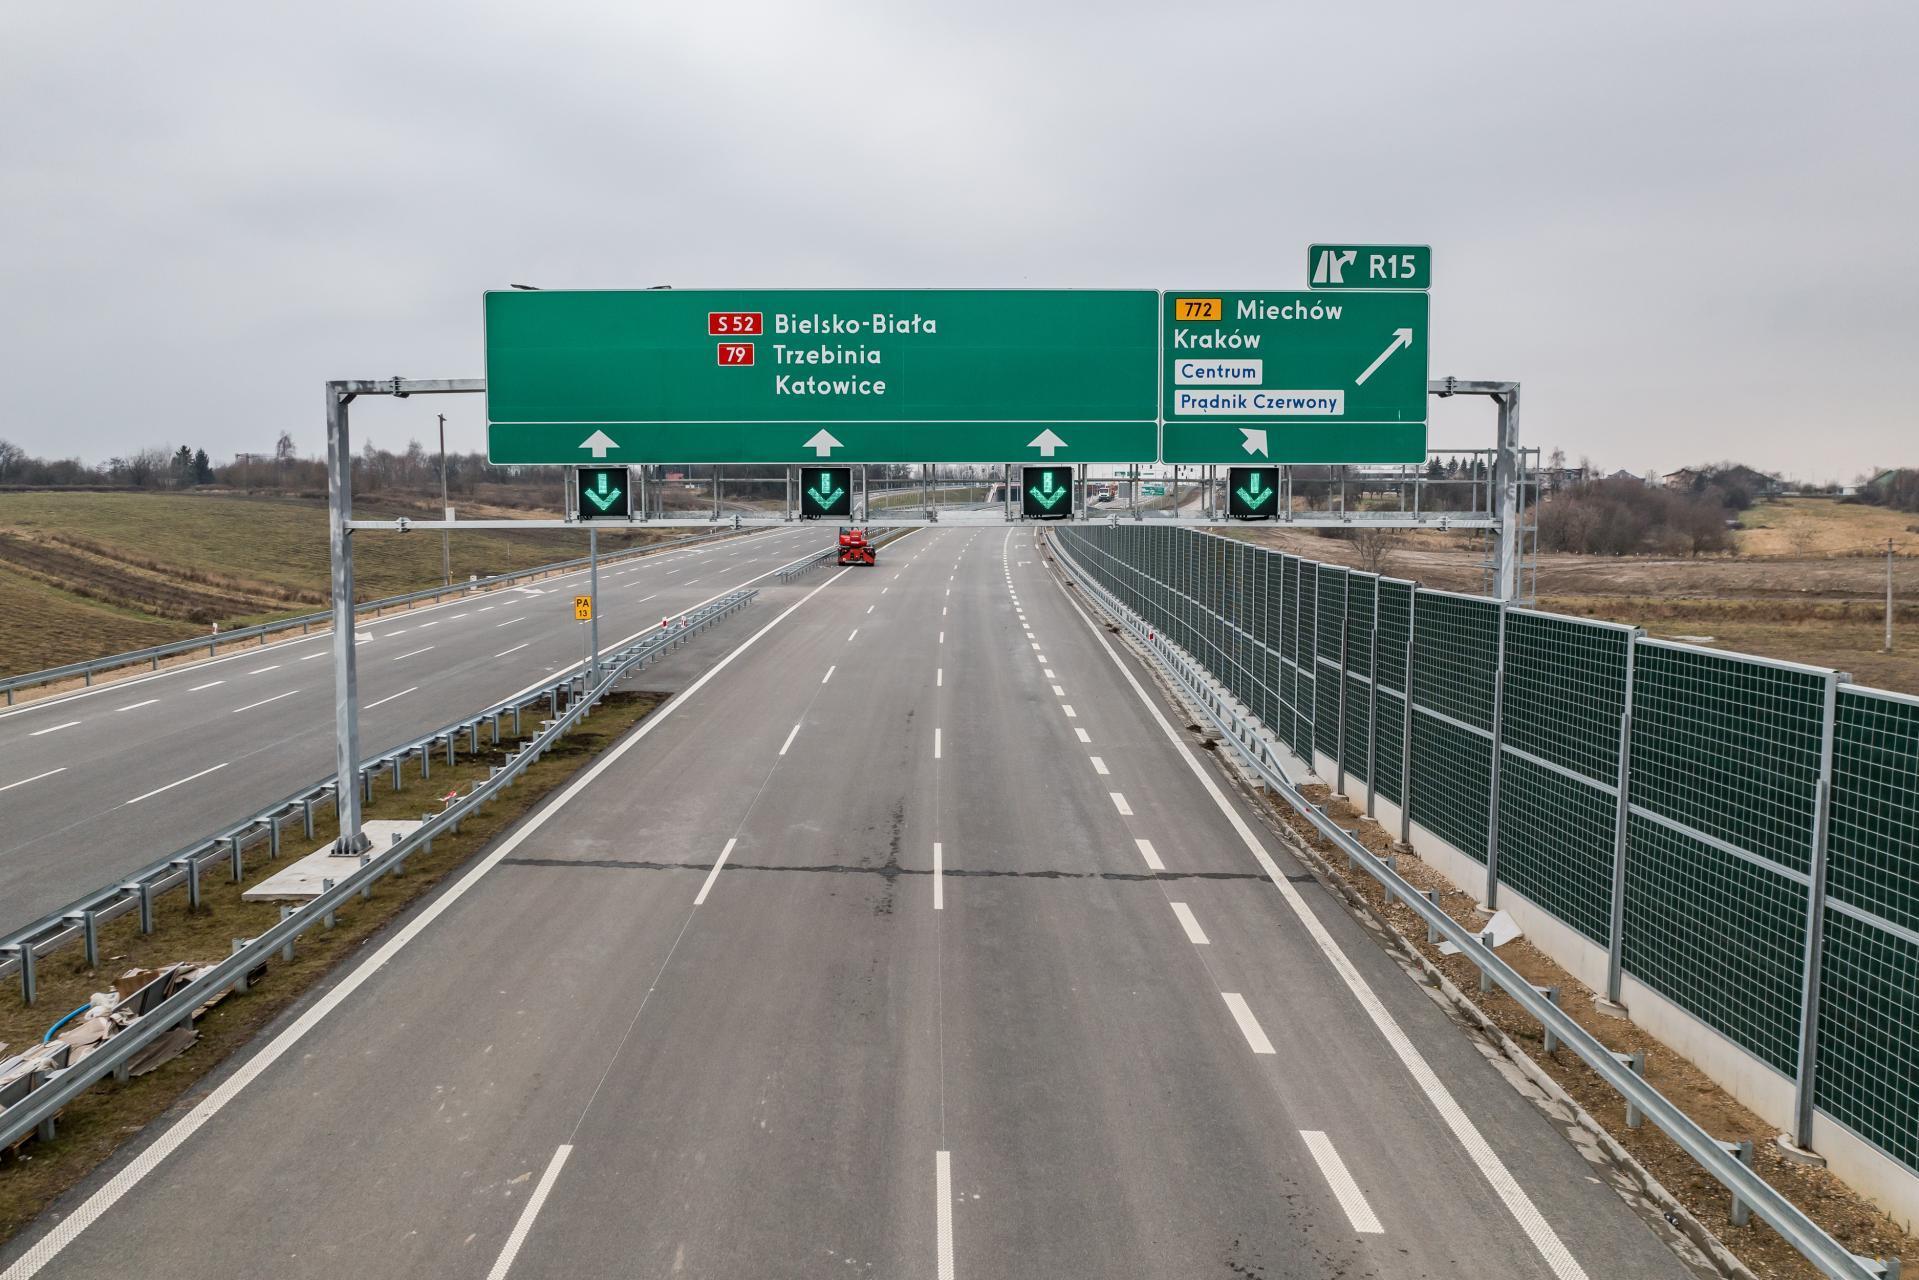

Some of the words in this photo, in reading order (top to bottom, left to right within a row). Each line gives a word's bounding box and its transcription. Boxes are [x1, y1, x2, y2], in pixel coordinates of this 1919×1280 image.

[1369, 254, 1416, 279] R15
[1184, 302, 1213, 317] 772
[1236, 299, 1343, 320] Miechów
[718, 316, 728, 332] S
[733, 316, 754, 332] 52
[775, 313, 937, 334] Bielsko-Biała
[1174, 329, 1261, 349] Kraków
[726, 346, 746, 363] 79
[773, 345, 881, 364] Trzebinia
[1181, 363, 1256, 379] Centrum
[776, 375, 886, 395] Katowice
[1181, 394, 1247, 413] Prądnik
[1253, 394, 1337, 412] Czerwony
[576, 599, 589, 607] PA
[579, 609, 587, 617] 13
